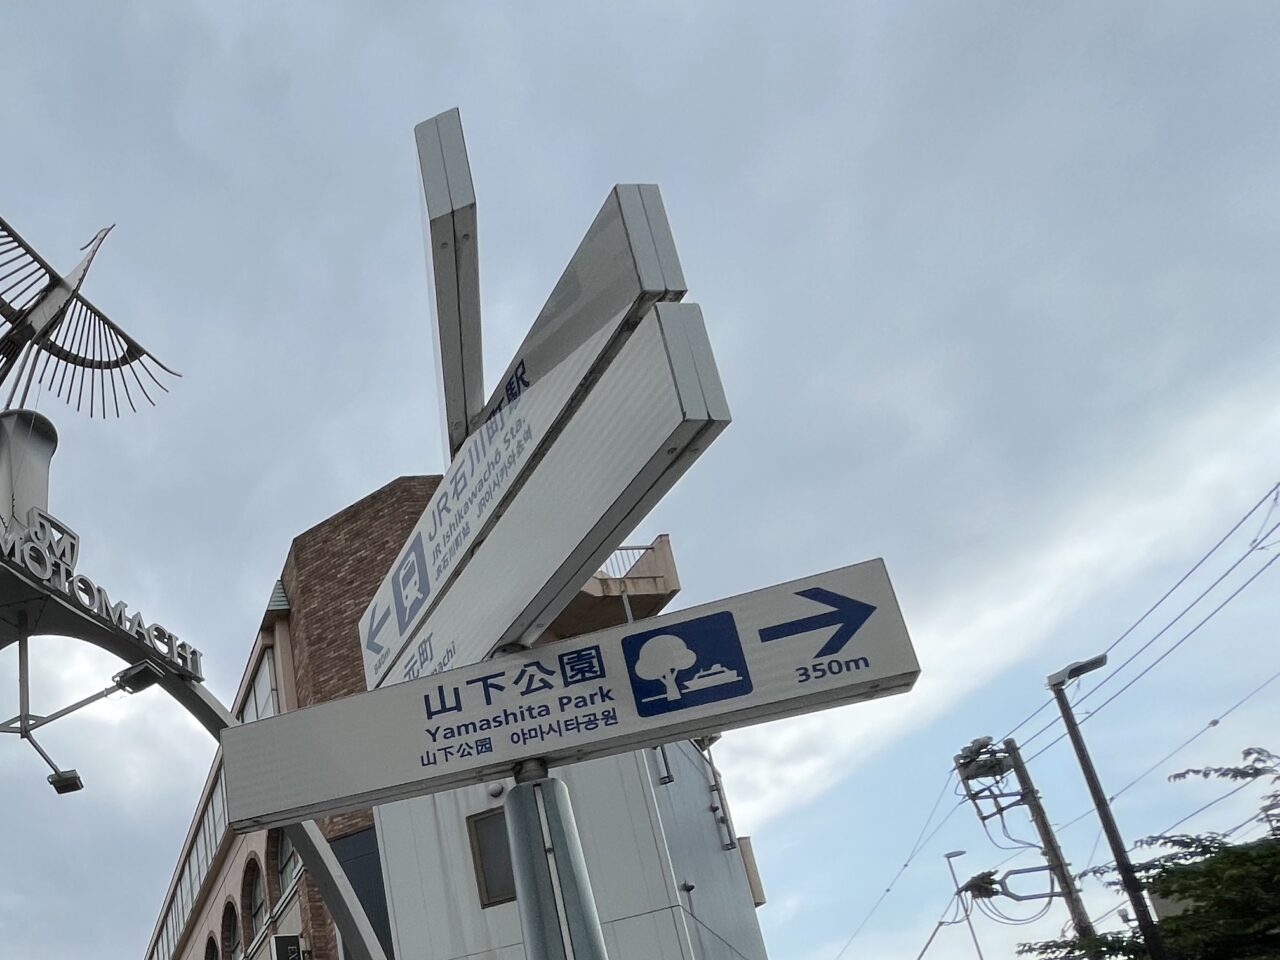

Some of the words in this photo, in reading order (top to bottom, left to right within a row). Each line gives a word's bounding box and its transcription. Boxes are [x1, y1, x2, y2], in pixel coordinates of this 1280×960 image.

[428, 358, 531, 543] JR石川町駅
[432, 542, 442, 565] JR
[503, 419, 526, 452] Sta.
[423, 645, 607, 721] 山下公園
[795, 656, 870, 683] 350m
[425, 703, 551, 743] Yamashita
[558, 686, 615, 713] Park
[510, 707, 620, 746] 야마시타공원
[420, 737, 494, 768] 山下公园
